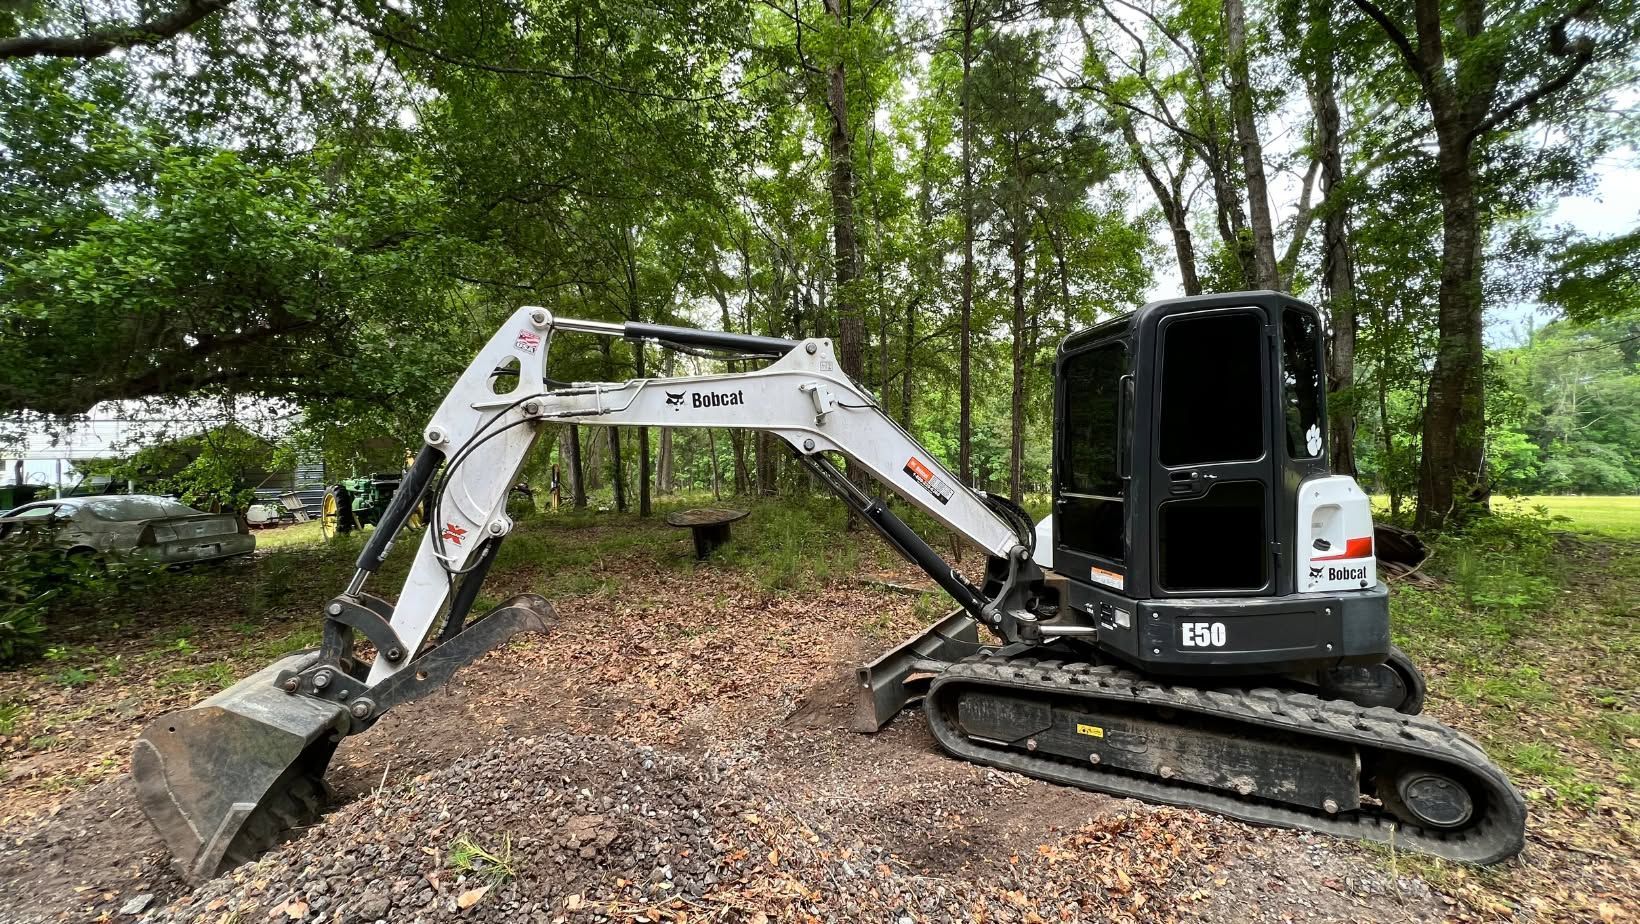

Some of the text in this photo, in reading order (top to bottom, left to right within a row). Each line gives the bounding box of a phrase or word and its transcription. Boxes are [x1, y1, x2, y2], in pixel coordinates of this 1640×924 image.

[692, 390, 744, 408] Bobcat
[1329, 566, 1367, 580] Bobcat
[1182, 622, 1226, 647] E50
